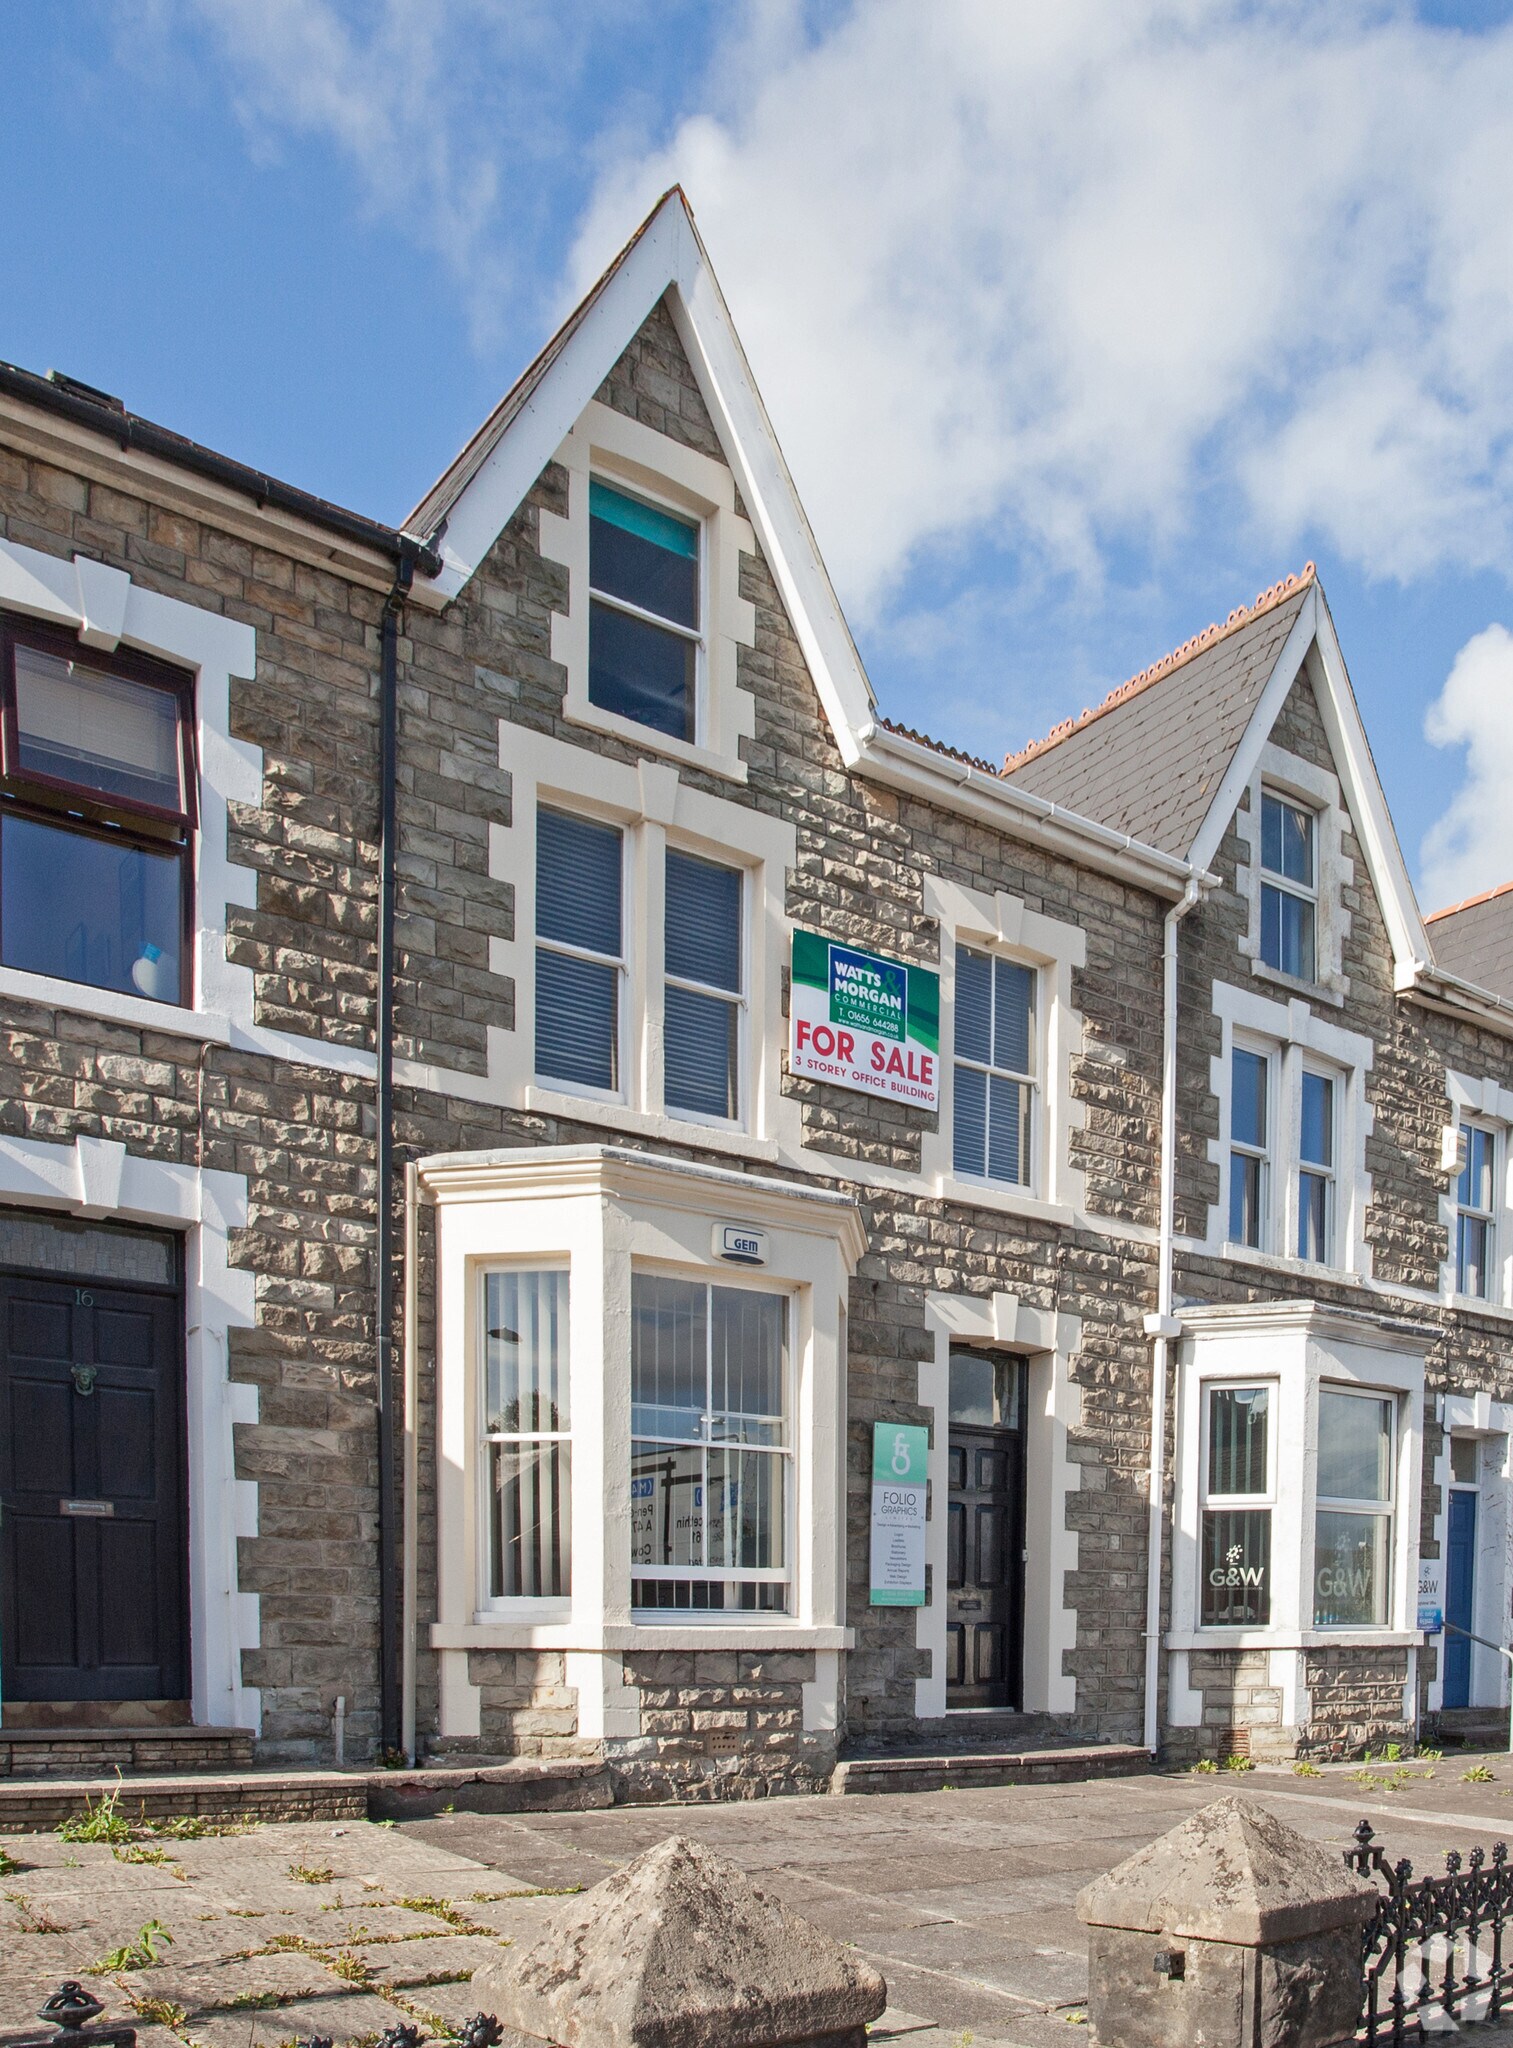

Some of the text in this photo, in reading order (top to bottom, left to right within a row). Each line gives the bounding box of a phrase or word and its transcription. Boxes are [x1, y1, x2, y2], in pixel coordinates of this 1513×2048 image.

[834, 960, 882, 988] WATTS
[834, 977, 902, 1011] MORGAN
[834, 993, 901, 1019] COMMERCIAL
[847, 1010, 871, 1025] 01656
[872, 1018, 899, 1033] 644288
[796, 1019, 933, 1086] FOR SALE
[795, 1055, 935, 1102] 3 STOREY OFFICE BUILDING
[734, 1238, 758, 1252] GEM
[76, 1288, 94, 1307] 16
[881, 1504, 918, 1517] GRAPHICS
[883, 1491, 917, 1506] FOLIO
[1209, 1567, 1265, 1587] G&W
[1317, 1567, 1371, 1598] G&W
